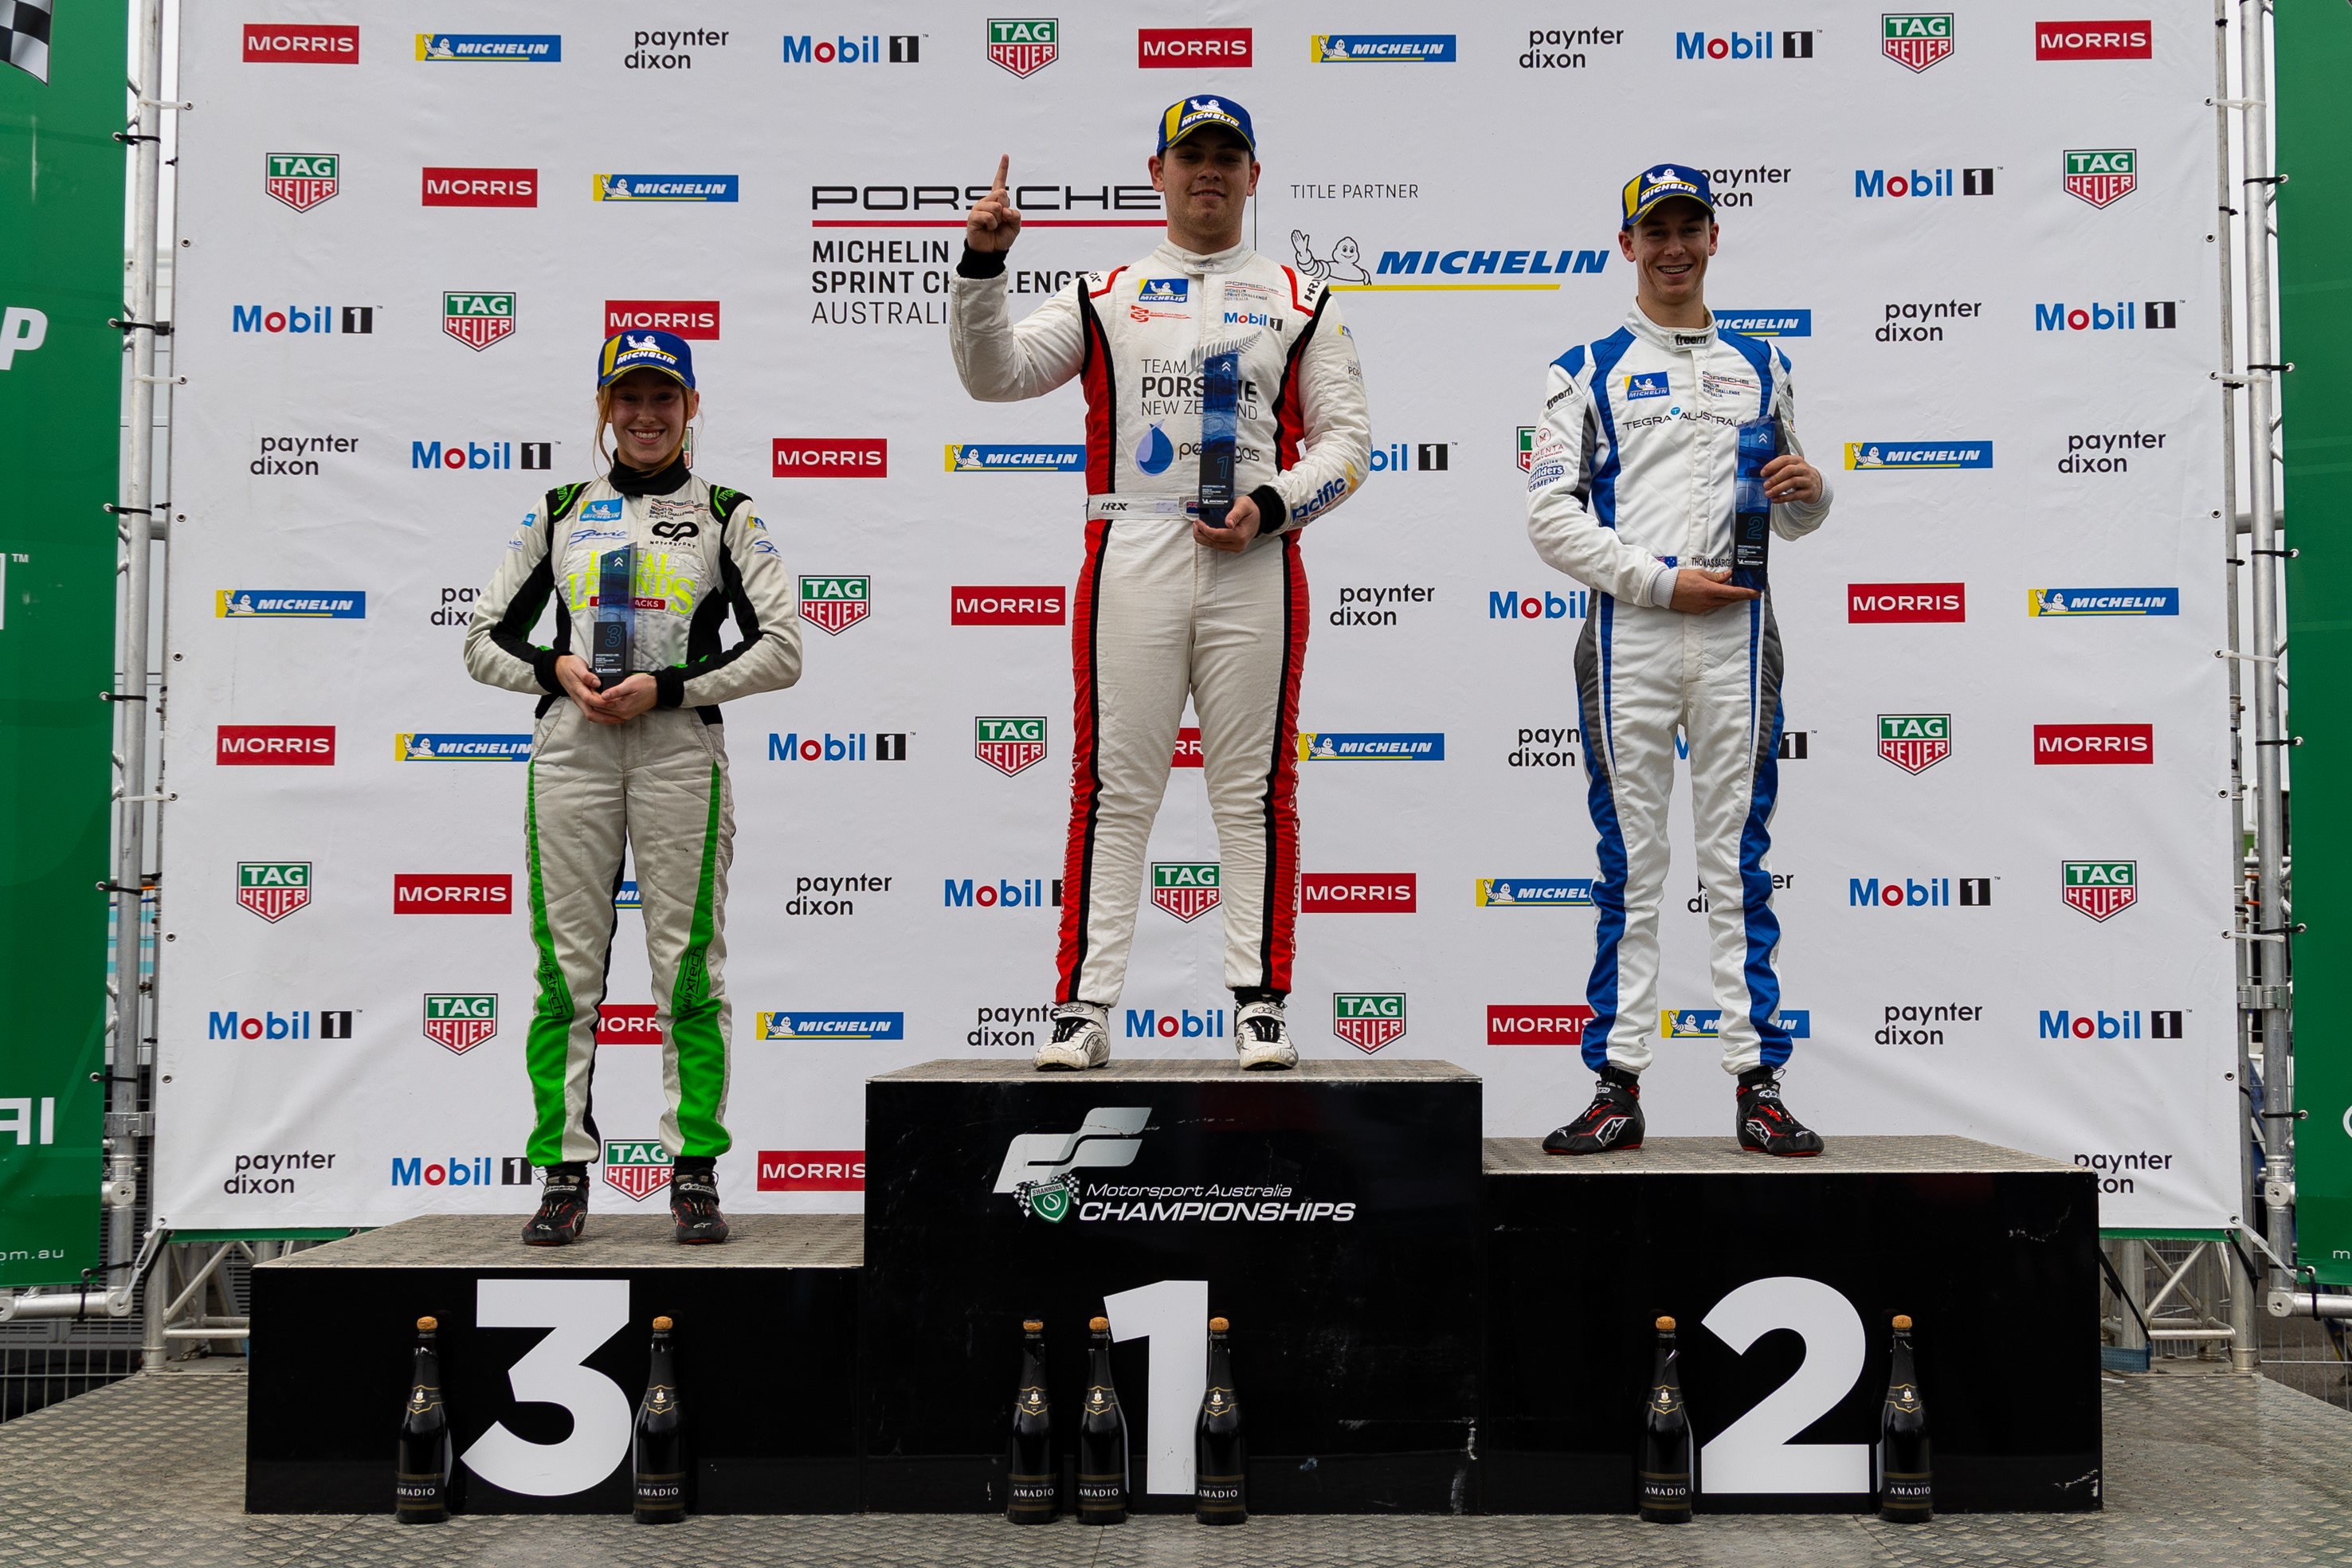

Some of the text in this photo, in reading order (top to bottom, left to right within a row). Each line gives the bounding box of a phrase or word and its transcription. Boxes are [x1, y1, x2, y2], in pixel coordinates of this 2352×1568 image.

[994, 24, 1051, 41] TAG
[1888, 18, 1946, 36] TAG
[249, 37, 353, 51] MORRIS
[635, 29, 728, 50] paynter
[1530, 27, 1624, 49] paynter
[1676, 32, 1772, 59] Mobil
[2041, 33, 2146, 48] MORRIS
[457, 44, 548, 53] MICHELIN
[784, 36, 878, 63] Mobil
[1144, 41, 1246, 55] MORRIS
[1353, 45, 1443, 53] MICHELIN
[1887, 40, 1949, 67] HEUER
[625, 50, 690, 69] dixon
[993, 45, 1053, 73] HEUER
[1519, 49, 1585, 68] dixon
[1182, 112, 1239, 127] MICHELIN
[273, 158, 331, 175] TAG
[2071, 154, 2129, 171] TAG
[428, 180, 531, 194] MORRIS
[635, 184, 726, 193] MICHELIN
[1291, 185, 1417, 198] TITLE PARTNER
[1856, 169, 1952, 197] Mobil
[2068, 176, 2131, 202] HEUER
[272, 180, 334, 206] HEUER
[812, 186, 1162, 210] PORSCHE
[1641, 184, 1697, 203] MICHELIN
[812, 241, 948, 264] MICHELIN
[1377, 250, 1609, 274] MICHELIN
[812, 272, 915, 293] SPRINT
[450, 296, 508, 314] TAG
[812, 302, 947, 324] AUSTRALI
[1886, 300, 1981, 322] paynter
[233, 305, 331, 333] Mobil
[611, 313, 714, 327] MORRIS
[1225, 312, 1267, 326] Mobil
[2036, 302, 2134, 331] Mobil
[449, 319, 511, 345] HEUER
[1876, 323, 1942, 342] dixon
[617, 351, 676, 365] MICHELIN
[1142, 359, 1186, 374] TEAM
[1142, 377, 1256, 403] PORSE
[1142, 401, 1258, 420] NEW ZEND
[1623, 410, 1743, 430] TEGRA AUSTRAL
[261, 435, 358, 456] paynter
[2069, 431, 2166, 453] paynter
[413, 441, 510, 469] Mobil
[778, 451, 881, 465] MORRIS
[986, 454, 1077, 463] MICHELIN
[1370, 444, 1407, 471] bil
[1887, 451, 1980, 461] MICHELIN
[2059, 454, 2127, 473] dixon
[251, 456, 318, 475] dixon
[1101, 502, 1128, 511] HRX
[1746, 516, 1764, 540] 2
[567, 573, 696, 614] LENDS
[806, 580, 863, 598] TAG
[1341, 584, 1434, 606] paynter
[258, 600, 352, 610] MICHELIN
[957, 599, 1060, 613] MORRIS
[1490, 591, 1586, 618] Mobil
[1854, 596, 1958, 610] MORRIS
[2072, 598, 2166, 607] MICHELIN
[804, 602, 865, 629] HEUER
[1331, 607, 1396, 625] dixon
[605, 625, 622, 647] 3
[982, 722, 1040, 739] TAG
[1885, 719, 1943, 737] TAG
[223, 739, 329, 752] MORRIS
[769, 734, 865, 761] Mobil
[1340, 743, 1432, 752] MICHELIN
[1519, 729, 1579, 747] payn
[2040, 737, 2146, 751] MORRIS
[437, 743, 531, 754] MICHELIN
[981, 743, 1042, 770] HEUER
[1508, 747, 1574, 766] dixon
[1883, 742, 1946, 769] HEUER
[245, 867, 304, 884] TAG
[1158, 867, 1216, 885] TAG
[2069, 865, 2129, 884] TAG
[400, 887, 506, 901] MORRIS
[797, 873, 892, 896] paynter
[945, 880, 1041, 907] Mobil
[1307, 886, 1410, 900] MORRIS
[1517, 888, 1590, 900] MICHEL
[1850, 879, 1948, 906] Mobil
[243, 889, 306, 917] HEUER
[786, 896, 853, 915] dixon
[1157, 889, 1218, 917] HEUER
[2068, 888, 2132, 915] HEUER
[431, 998, 490, 1017] TAG
[978, 1003, 1059, 1027] paynte
[1341, 998, 1398, 1016] TAG
[1886, 1003, 1982, 1025] paynter
[210, 1011, 309, 1040] Mobil
[798, 1022, 891, 1031] MICHELIN
[1127, 1009, 1223, 1037] Mobil
[2040, 1010, 2140, 1039] Mobil
[429, 1021, 492, 1049] HEUER
[967, 1027, 1033, 1045] dixon
[1339, 1020, 1401, 1048] HEUER
[1875, 1025, 1942, 1045] dixon
[236, 1151, 335, 1174] paynter
[611, 1145, 668, 1162] TAG
[2074, 1151, 2172, 1169] paynter
[392, 1158, 491, 1186] Mobil
[762, 1163, 864, 1179] MORRIS
[225, 1174, 294, 1194] dixon
[609, 1167, 671, 1195] HEUER
[1032, 1184, 1064, 1195] SHANNONS
[1087, 1183, 1293, 1200] Motorsport Australia
[1079, 1202, 1356, 1222] CHAMPIONSHIPS
[461, 1279, 633, 1496] 3
[1103, 1280, 1209, 1495] 1
[1701, 1276, 1870, 1494] 2
[397, 1488, 436, 1496] AMADIO
[637, 1488, 679, 1496] AMADIO
[1013, 1488, 1054, 1498] AMADIO
[1079, 1488, 1119, 1498] AMADIO
[1198, 1489, 1238, 1499] AMADIO
[1644, 1487, 1686, 1496] AMADIO
[1890, 1486, 1931, 1495] AMADIO
